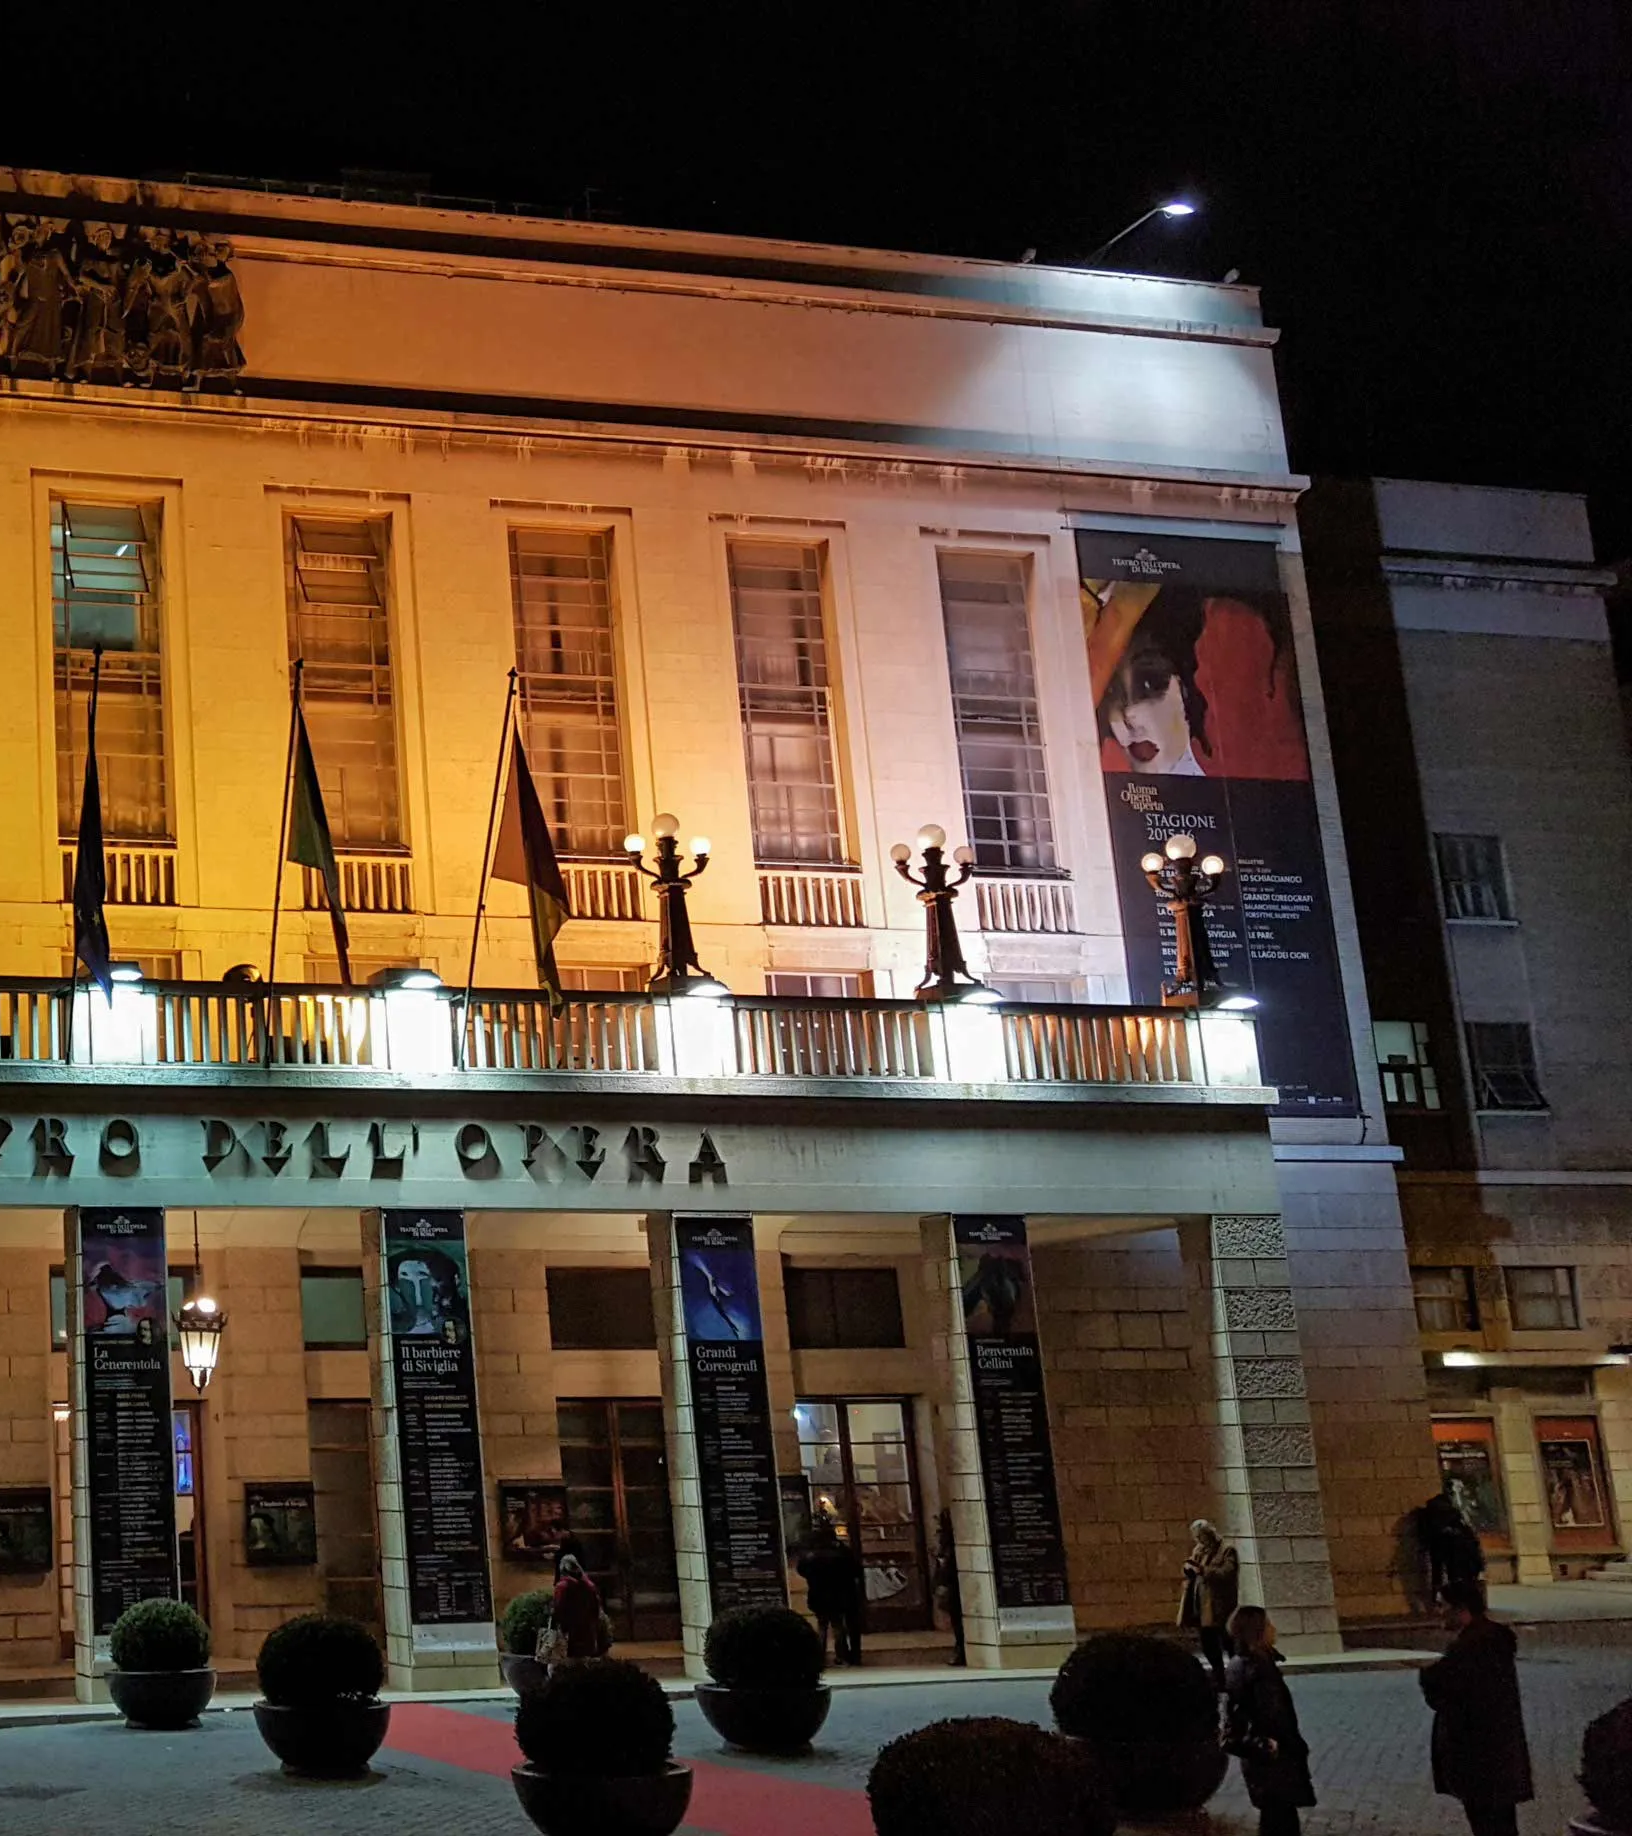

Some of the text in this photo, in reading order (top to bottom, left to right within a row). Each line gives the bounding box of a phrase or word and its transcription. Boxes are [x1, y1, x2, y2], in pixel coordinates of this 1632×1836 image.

[1142, 567, 1164, 575] ROMA
[1128, 782, 1158, 796] Roma
[1120, 790, 1152, 804] Opera
[1133, 800, 1165, 812] aperta
[1145, 813, 1217, 829] STAGIONE
[1147, 827, 1195, 841] 20156
[1240, 874, 1249, 882] LO
[1243, 893, 1270, 901] GRANDI
[1208, 930, 1237, 939] SIVIGLIA
[1248, 931, 1274, 940] LE PARC
[1258, 950, 1277, 959] LAGO
[94, 1346, 109, 1359] La
[401, 1346, 461, 1359] Il barbiere
[696, 1345, 737, 1359] Grandi
[976, 1345, 1034, 1357] Benvenuto
[94, 1358, 161, 1371] Cenerentola
[402, 1359, 458, 1375] di Siviglia
[697, 1359, 758, 1375] Coreografi
[977, 1357, 1014, 1369] Cellini
